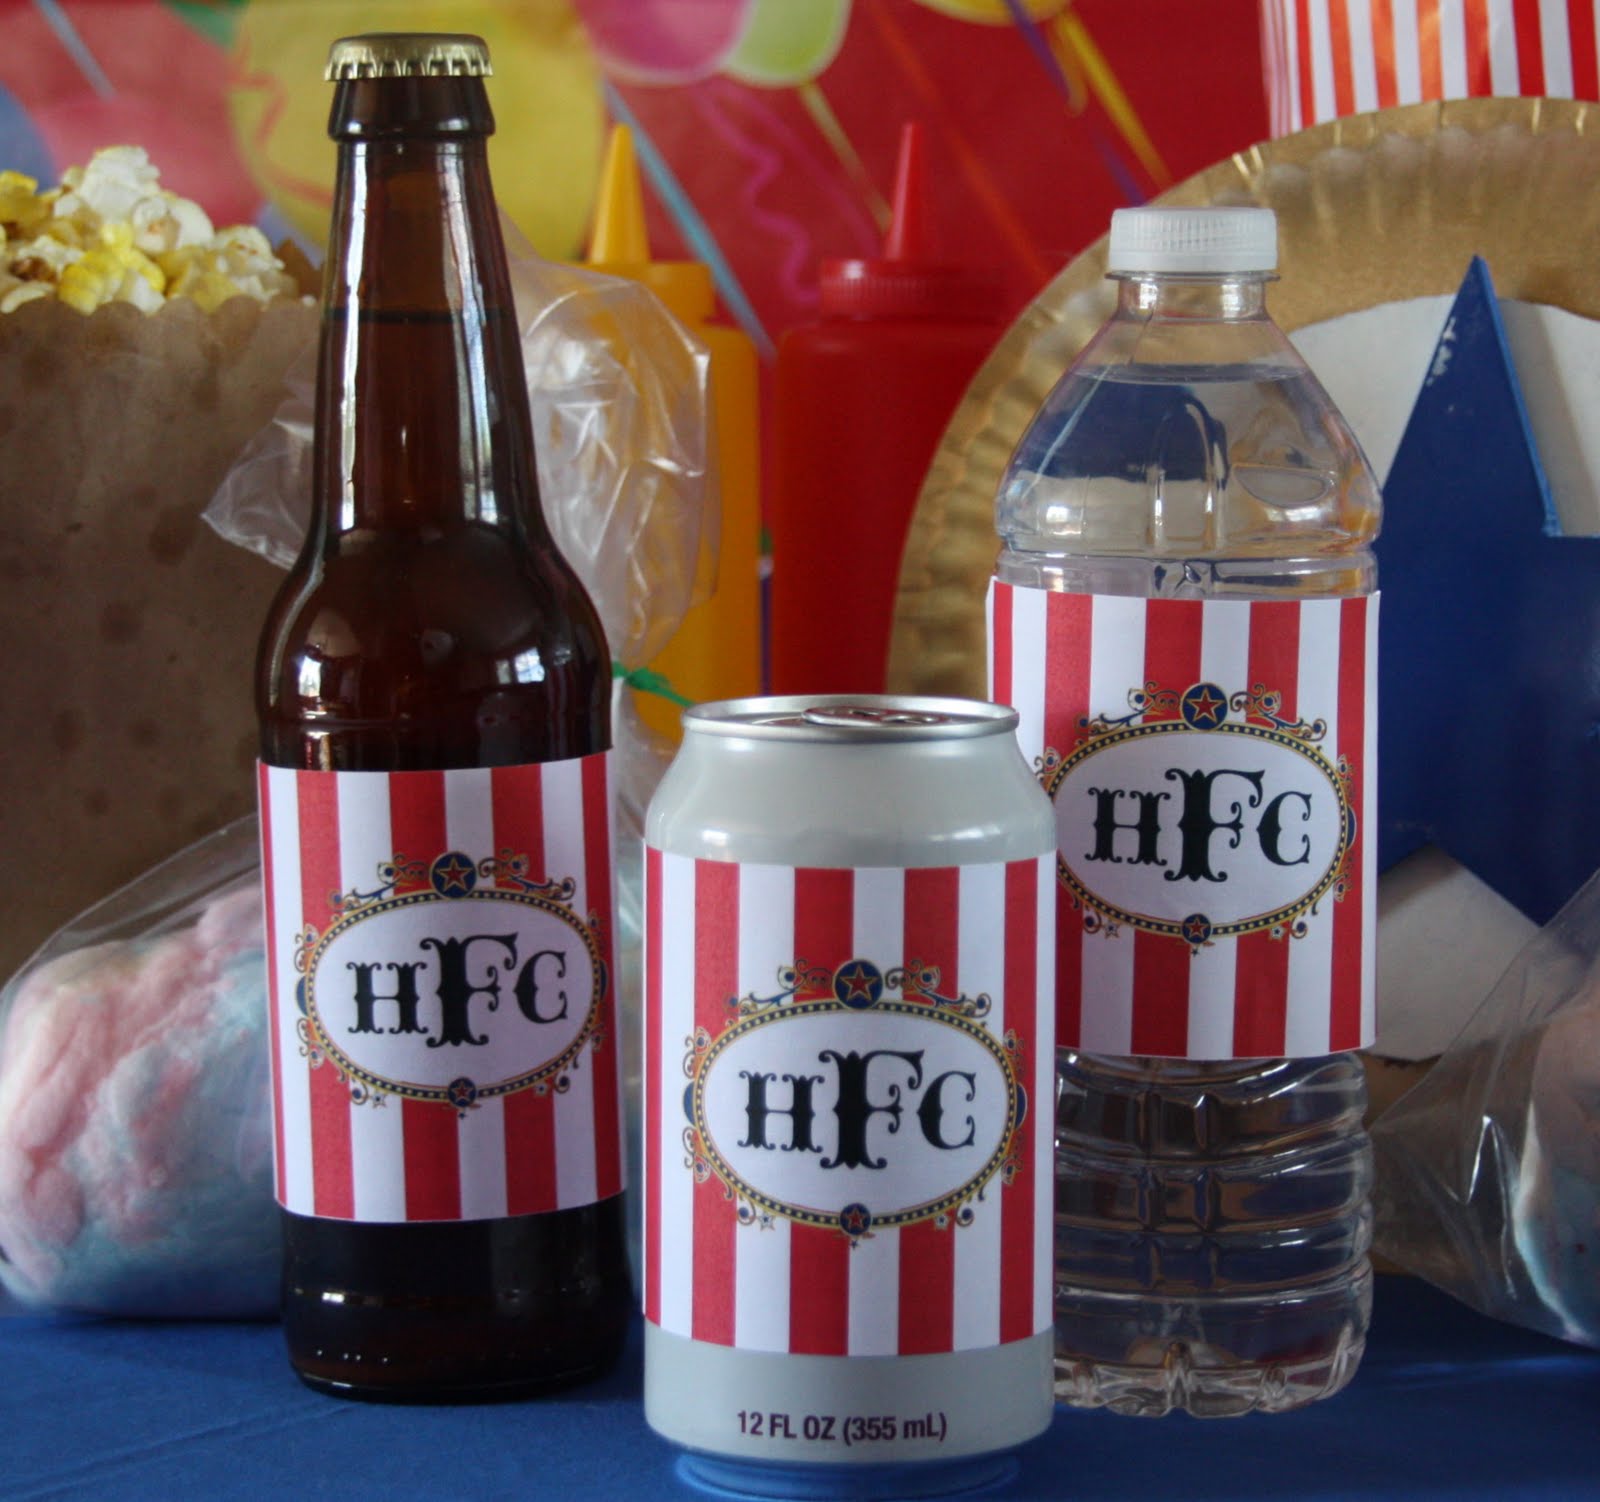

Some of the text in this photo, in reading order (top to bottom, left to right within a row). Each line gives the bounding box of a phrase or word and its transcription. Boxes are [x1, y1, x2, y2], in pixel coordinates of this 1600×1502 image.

[1084, 766, 1311, 883] HFC
[346, 931, 569, 1049] HFC
[737, 1049, 976, 1171] HFC
[737, 1410, 948, 1446] 12 FL OZ (355 mL)
